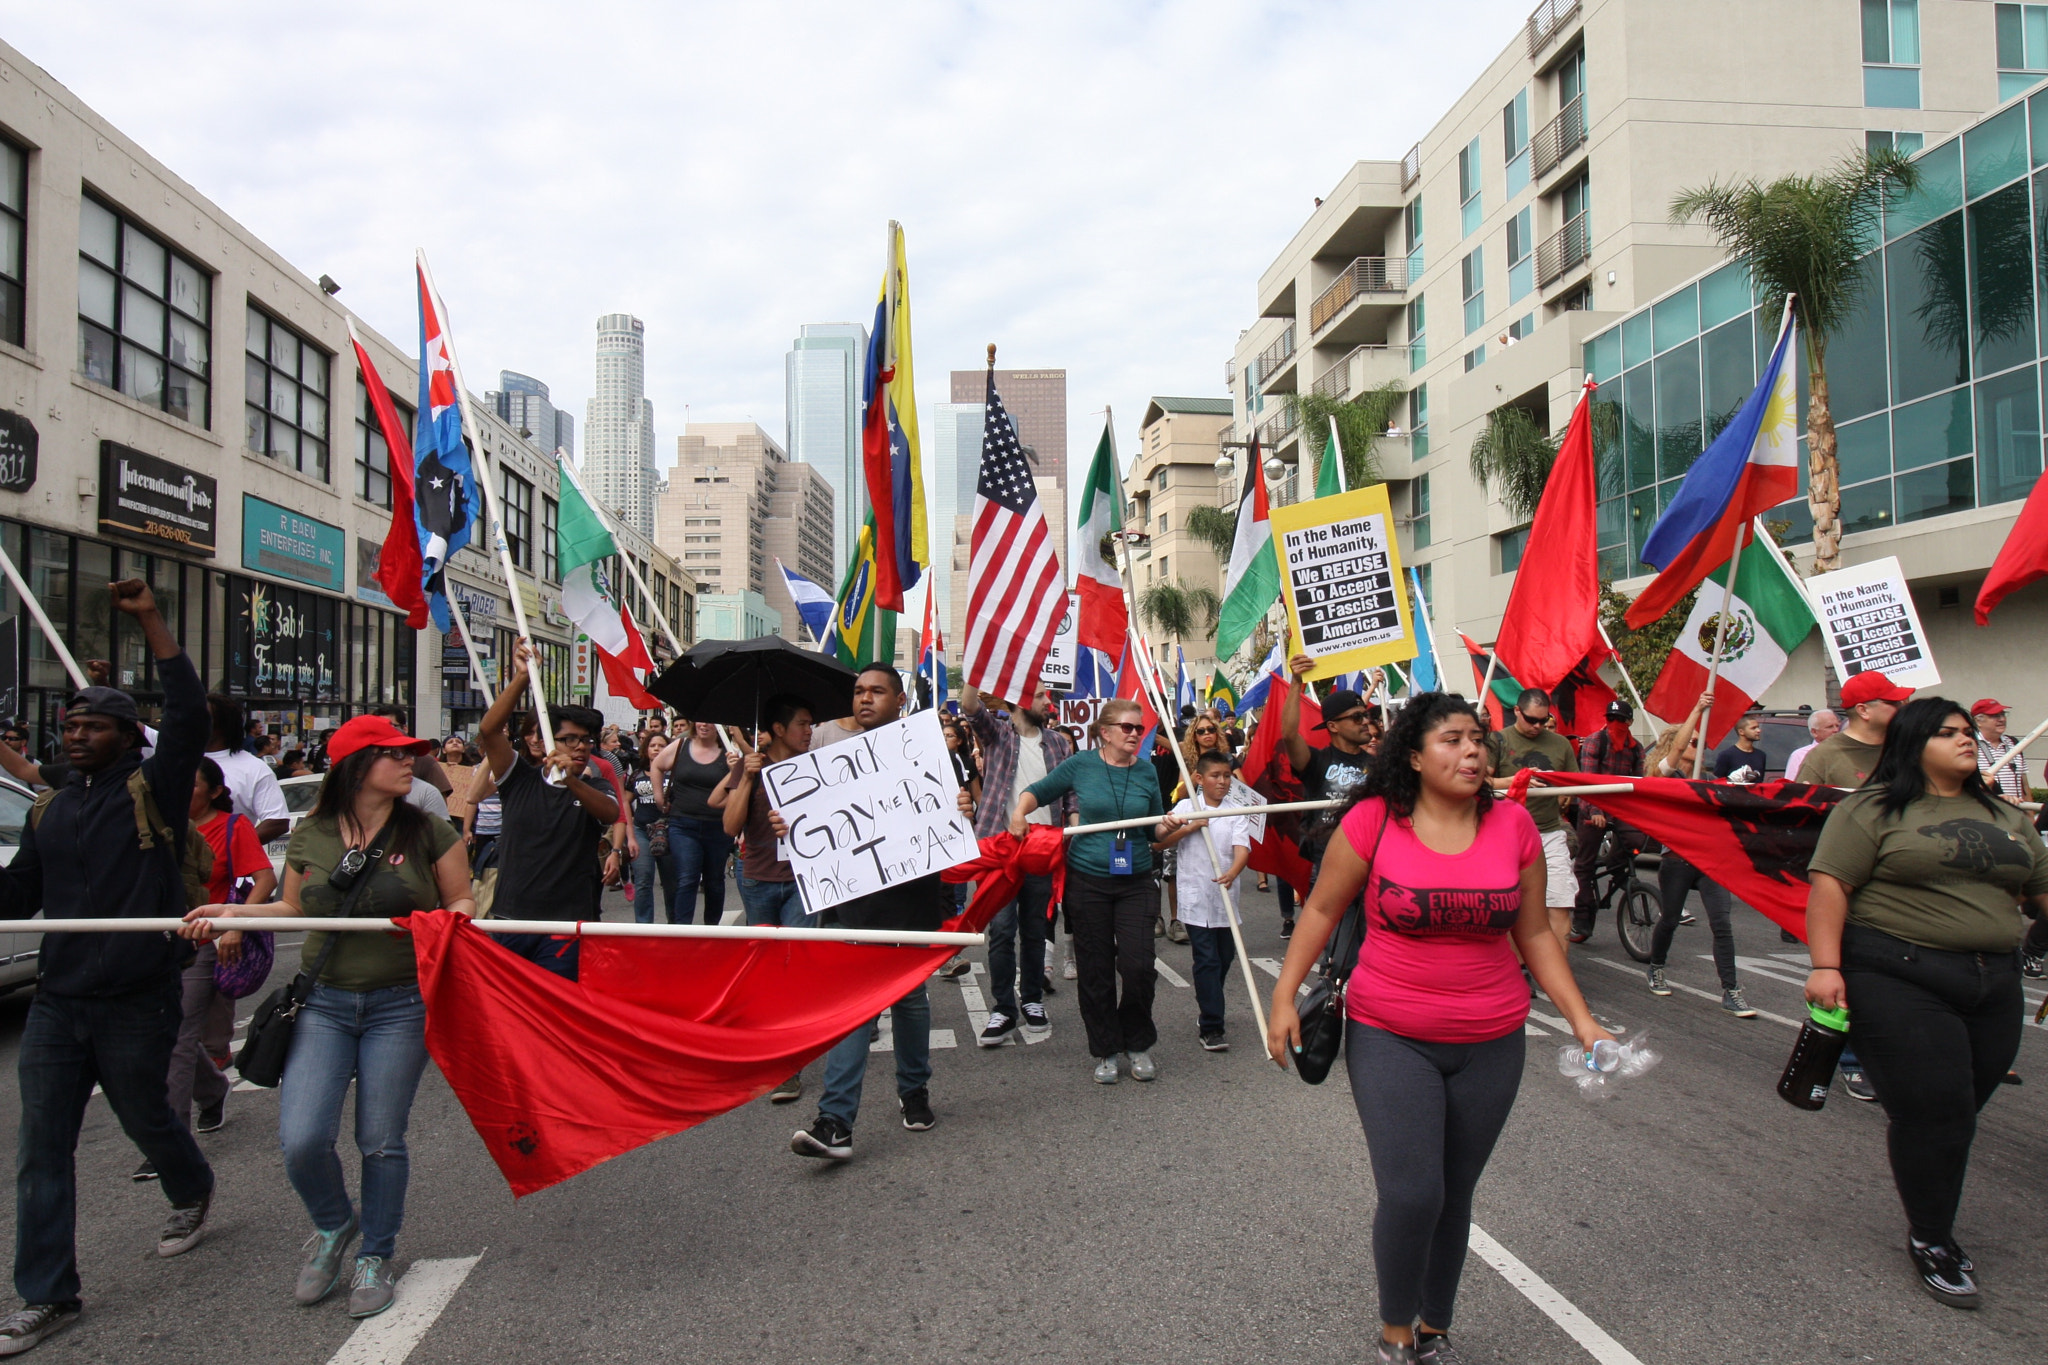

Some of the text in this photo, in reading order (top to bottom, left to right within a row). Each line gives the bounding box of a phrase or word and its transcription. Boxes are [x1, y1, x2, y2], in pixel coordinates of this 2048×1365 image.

[119, 460, 212, 512] International Trade
[280, 515, 288, 531] R
[1286, 520, 1371, 548] In the Name
[260, 528, 316, 560] ENTERPRISES
[1290, 536, 1378, 564] of Humanity,
[1297, 554, 1384, 585] We REFUSE
[1308, 575, 1379, 603] To Accept
[1821, 581, 1889, 605] In the Name
[1314, 594, 1379, 622] a Fascist
[1826, 604, 1838, 617] of
[1833, 605, 1903, 632] We REFUSE
[1322, 616, 1380, 640] America
[1844, 622, 1902, 645] To Accept
[1315, 632, 1391, 654] www.revcom.us
[1853, 636, 1905, 659] a Fascist
[1860, 652, 1907, 672] America
[1063, 699, 1102, 724] NOT
[766, 732, 888, 808] Black
[789, 795, 875, 859] Gay
[852, 836, 917, 885] Trump
[910, 834, 921, 853] go
[926, 816, 967, 869] Away
[1429, 891, 1521, 911] ETHNIC STUD
